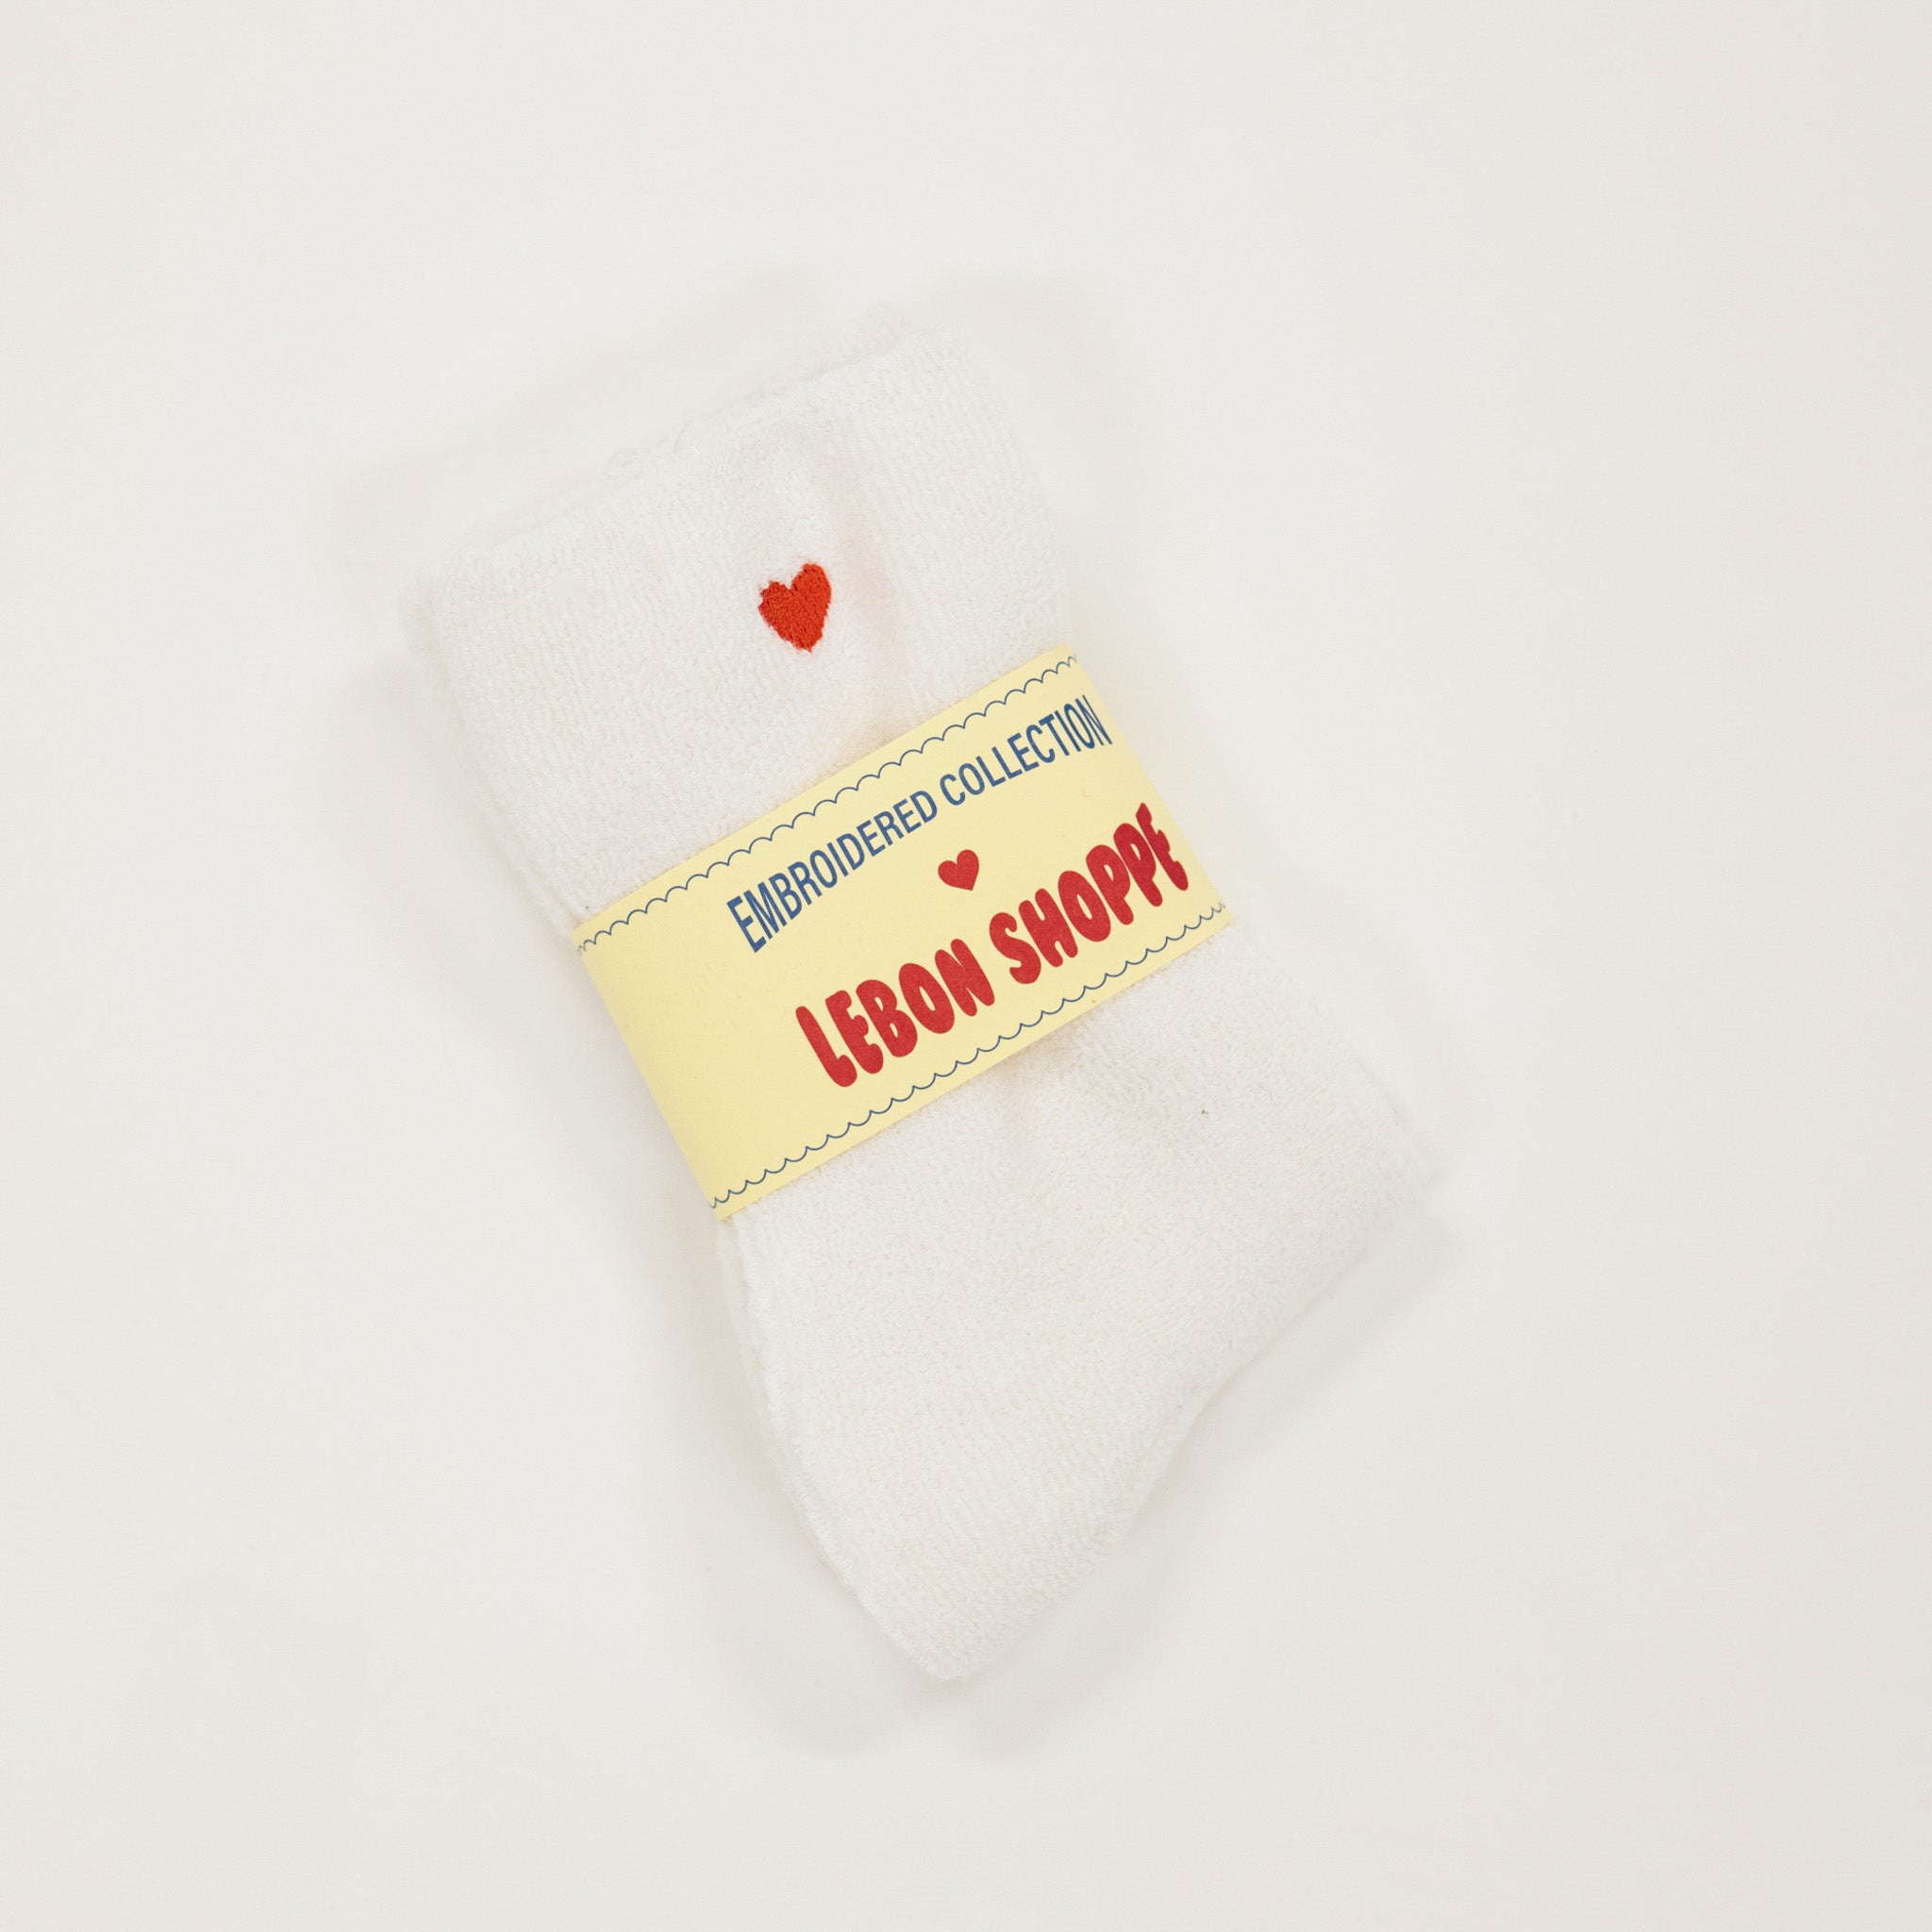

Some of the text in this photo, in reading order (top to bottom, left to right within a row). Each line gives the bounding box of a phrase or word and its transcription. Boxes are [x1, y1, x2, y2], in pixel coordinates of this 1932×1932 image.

[726, 693, 1112, 953] EMBROIDERED COLLECTION
[795, 802, 1190, 1089] LEBON SHOPPE
